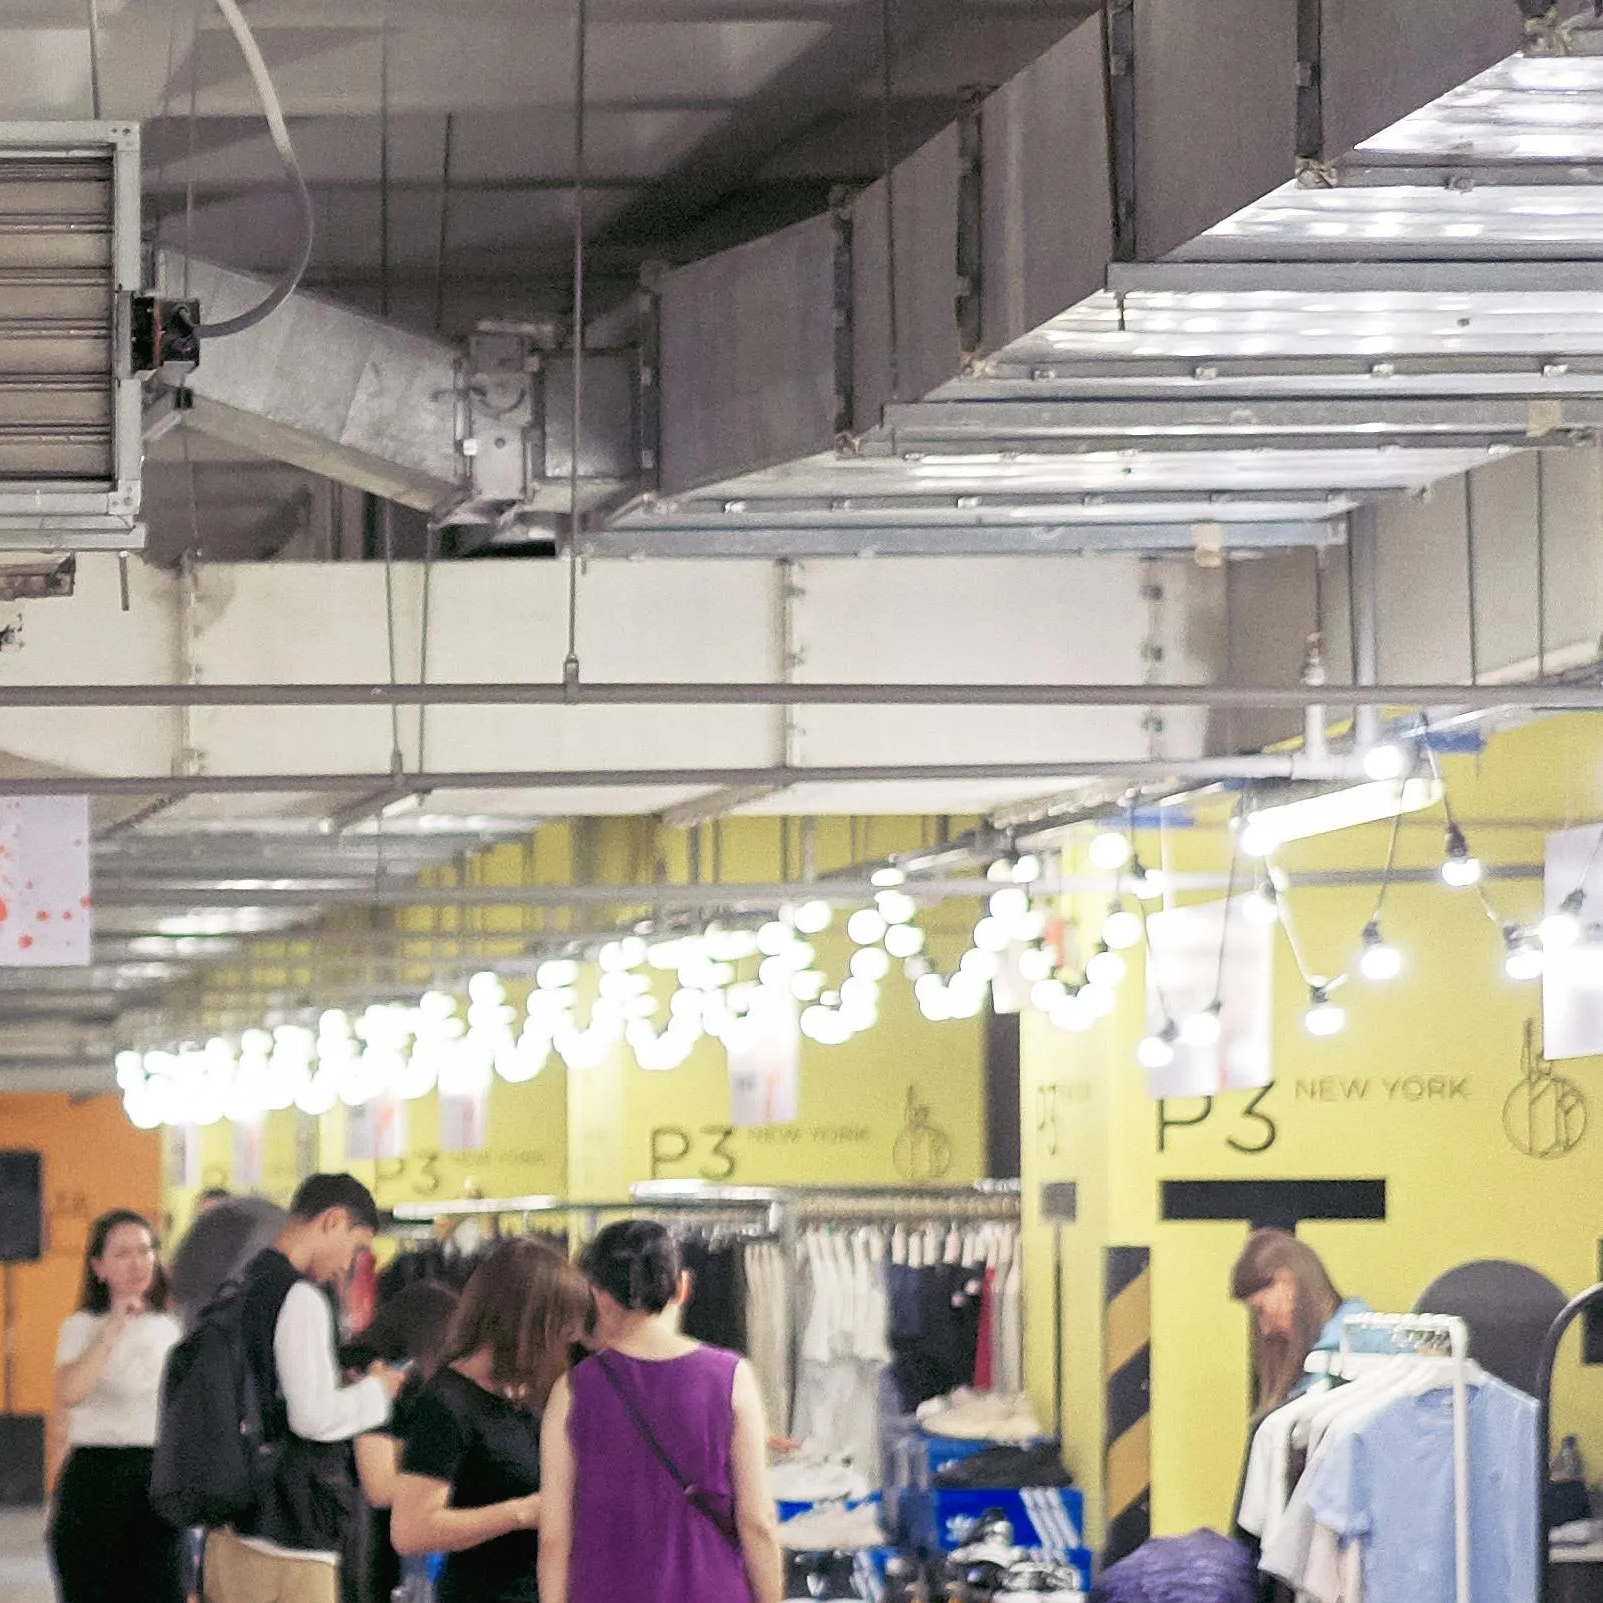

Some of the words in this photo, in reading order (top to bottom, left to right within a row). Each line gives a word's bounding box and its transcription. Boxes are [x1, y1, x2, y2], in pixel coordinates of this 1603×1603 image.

[1158, 1077, 1277, 1153] P3
[1295, 1078, 1371, 1101] NEW
[1382, 1077, 1472, 1101] YORK
[650, 1124, 736, 1181] P3
